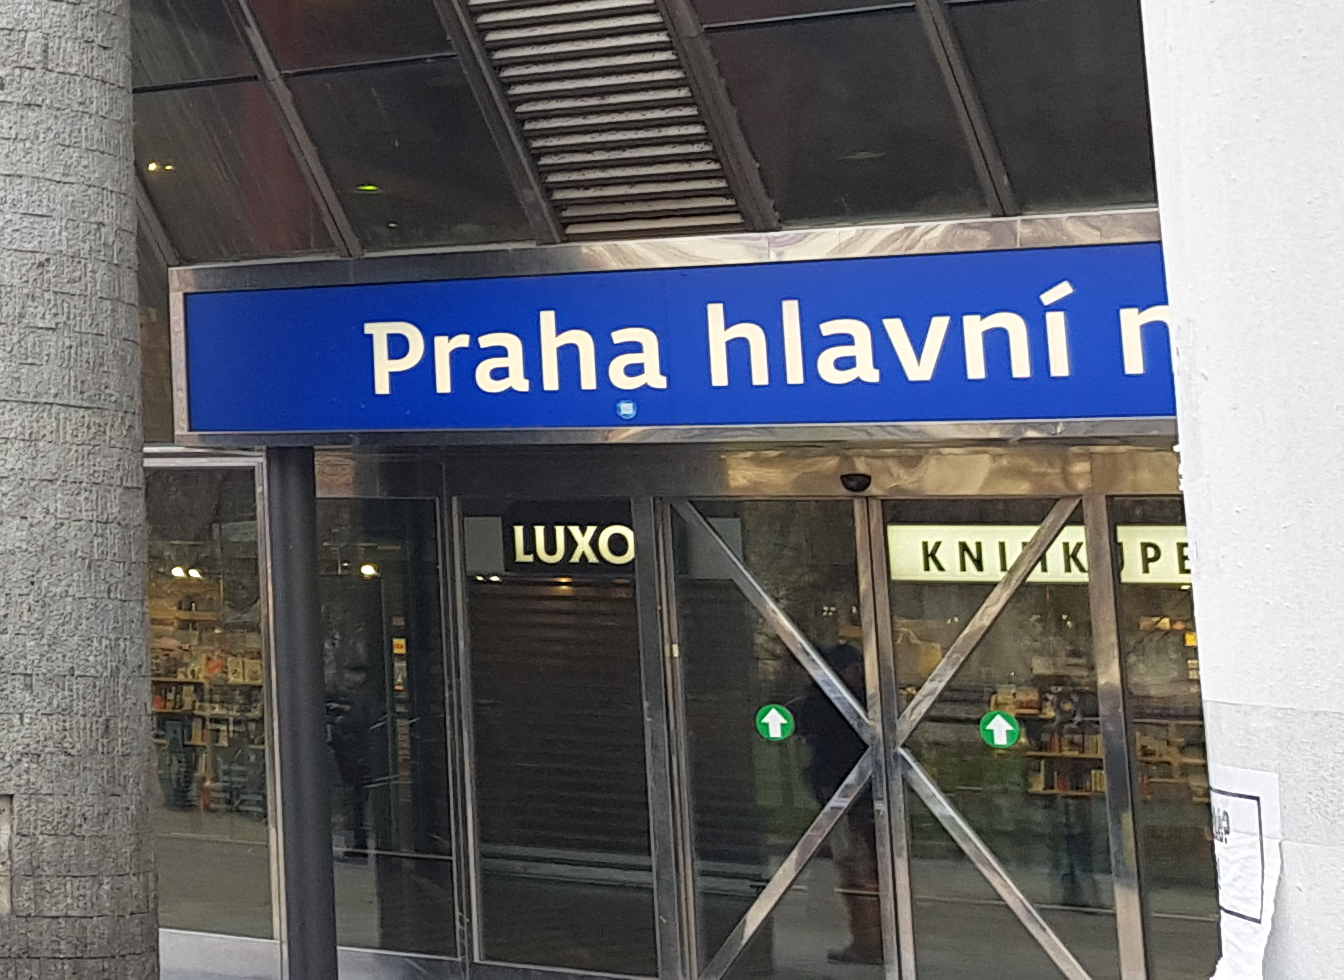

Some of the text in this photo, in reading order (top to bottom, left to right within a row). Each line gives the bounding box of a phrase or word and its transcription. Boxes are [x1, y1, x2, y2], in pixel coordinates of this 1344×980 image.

[363, 280, 1173, 395] Praha hlavní n
[513, 522, 635, 566] LUXO
